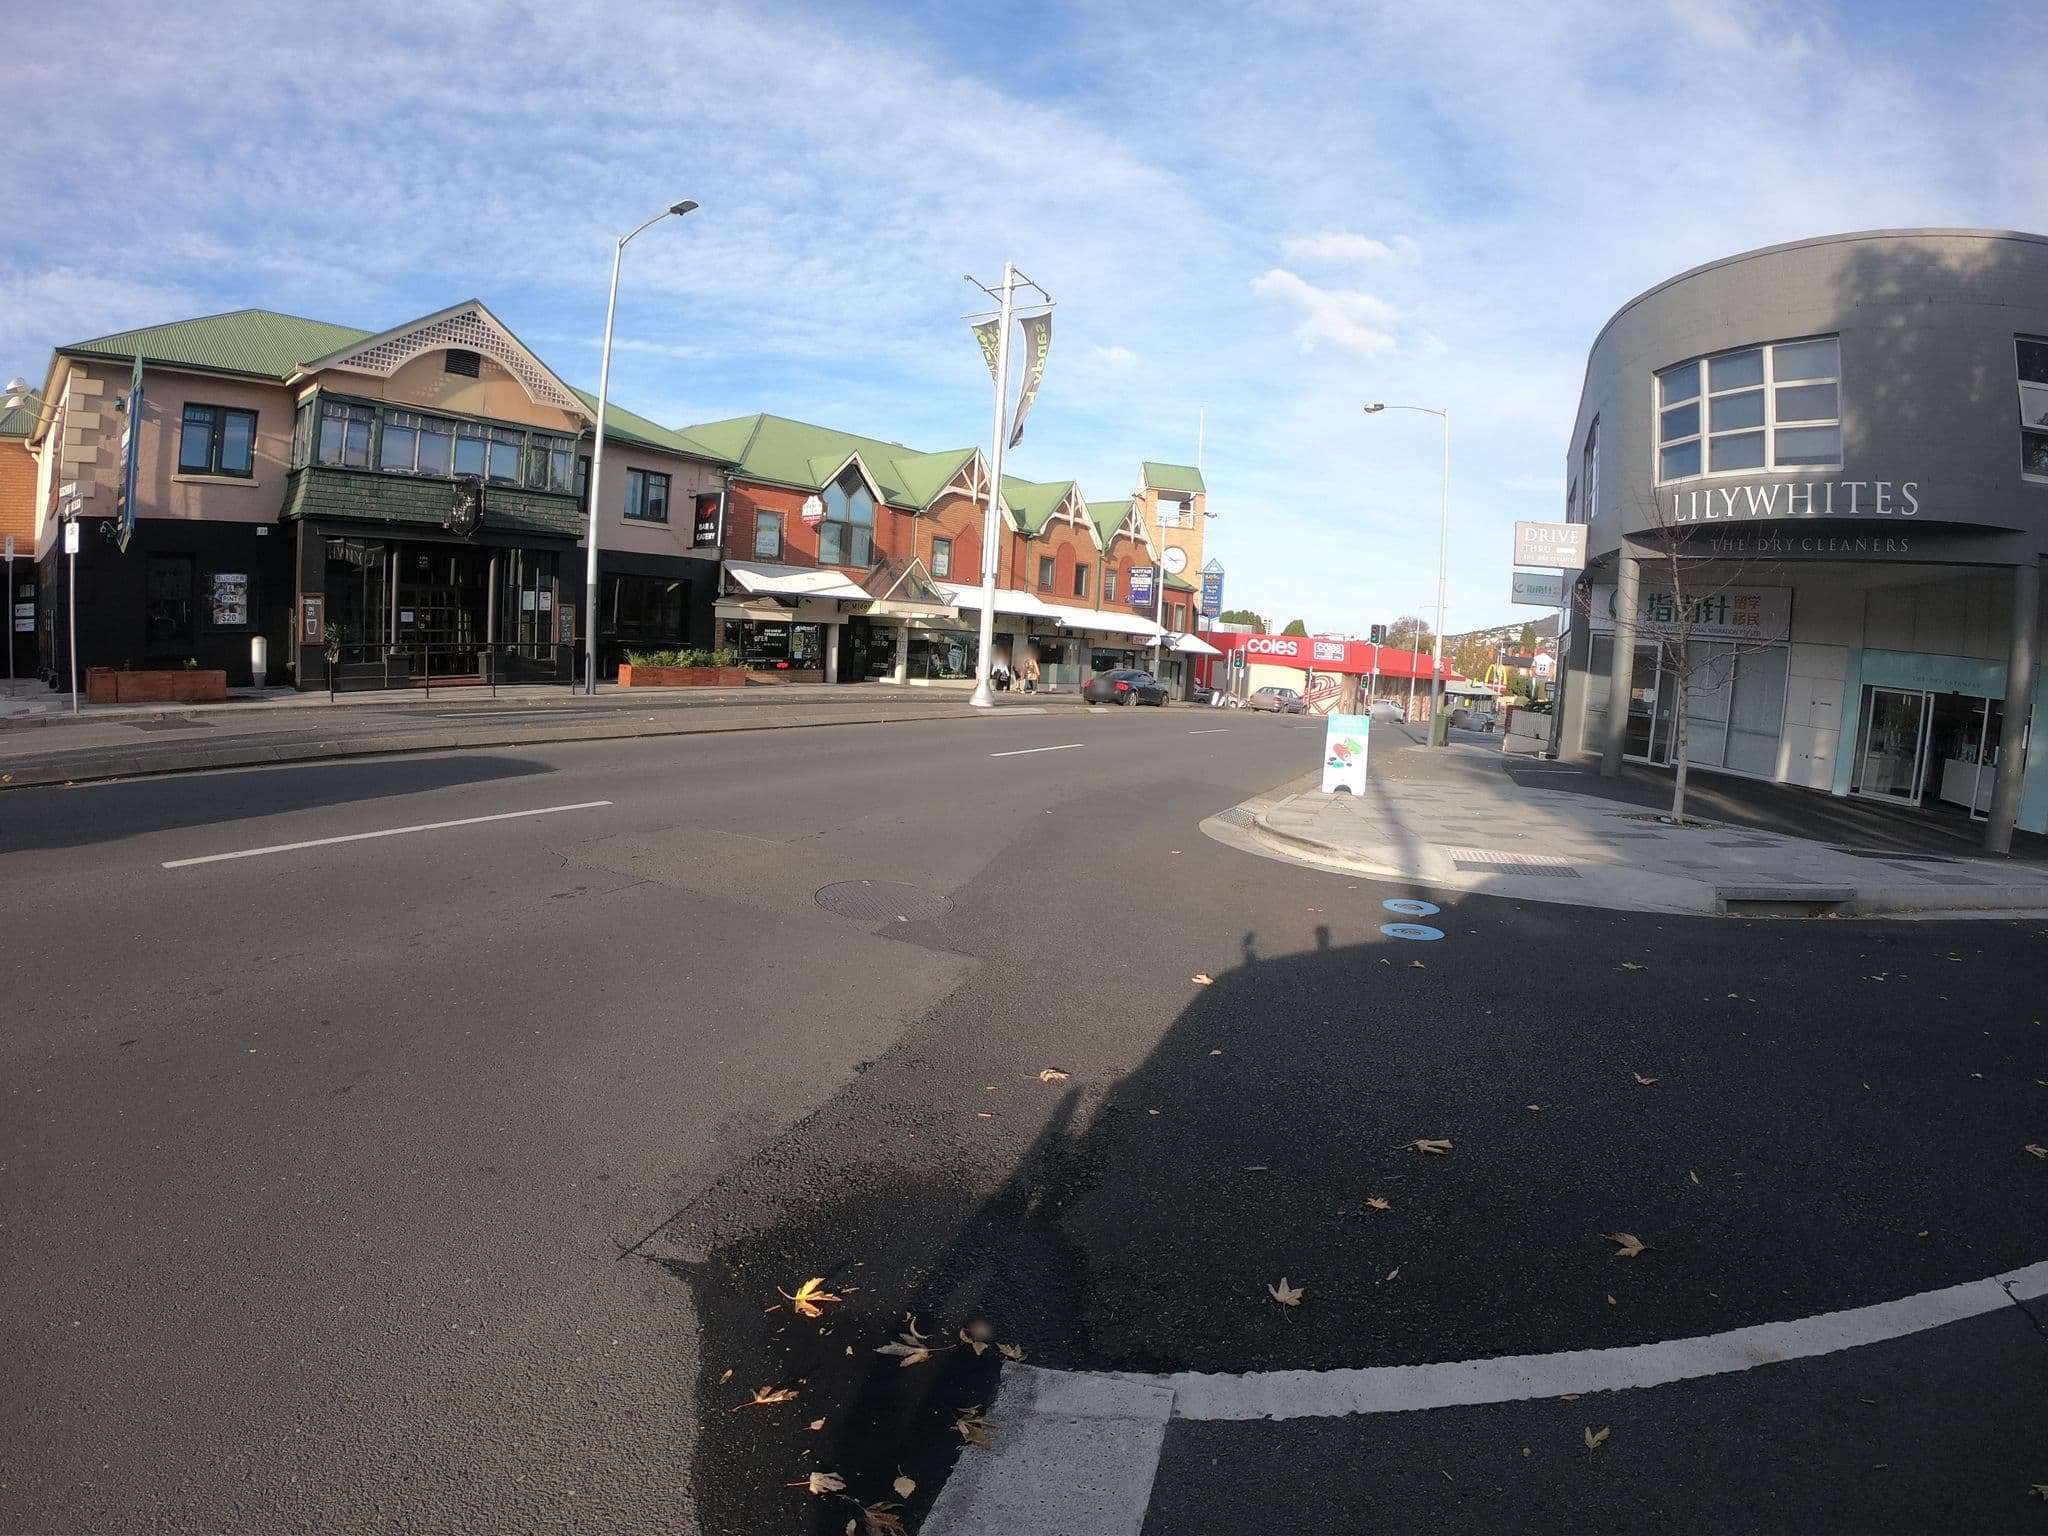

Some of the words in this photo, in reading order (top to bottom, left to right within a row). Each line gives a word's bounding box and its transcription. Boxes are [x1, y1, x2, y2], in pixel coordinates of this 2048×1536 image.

[1674, 481, 1919, 522] LILYWHITES
[696, 532, 716, 541] EATERY
[1524, 527, 1579, 544] DRIVE
[1523, 543, 1551, 554] THRU
[1711, 538, 1745, 551] THE
[1757, 538, 1794, 551] DRY
[1801, 538, 1910, 552] CLEANERS
[221, 613, 237, 621] $20
[1247, 638, 1298, 656] coles
